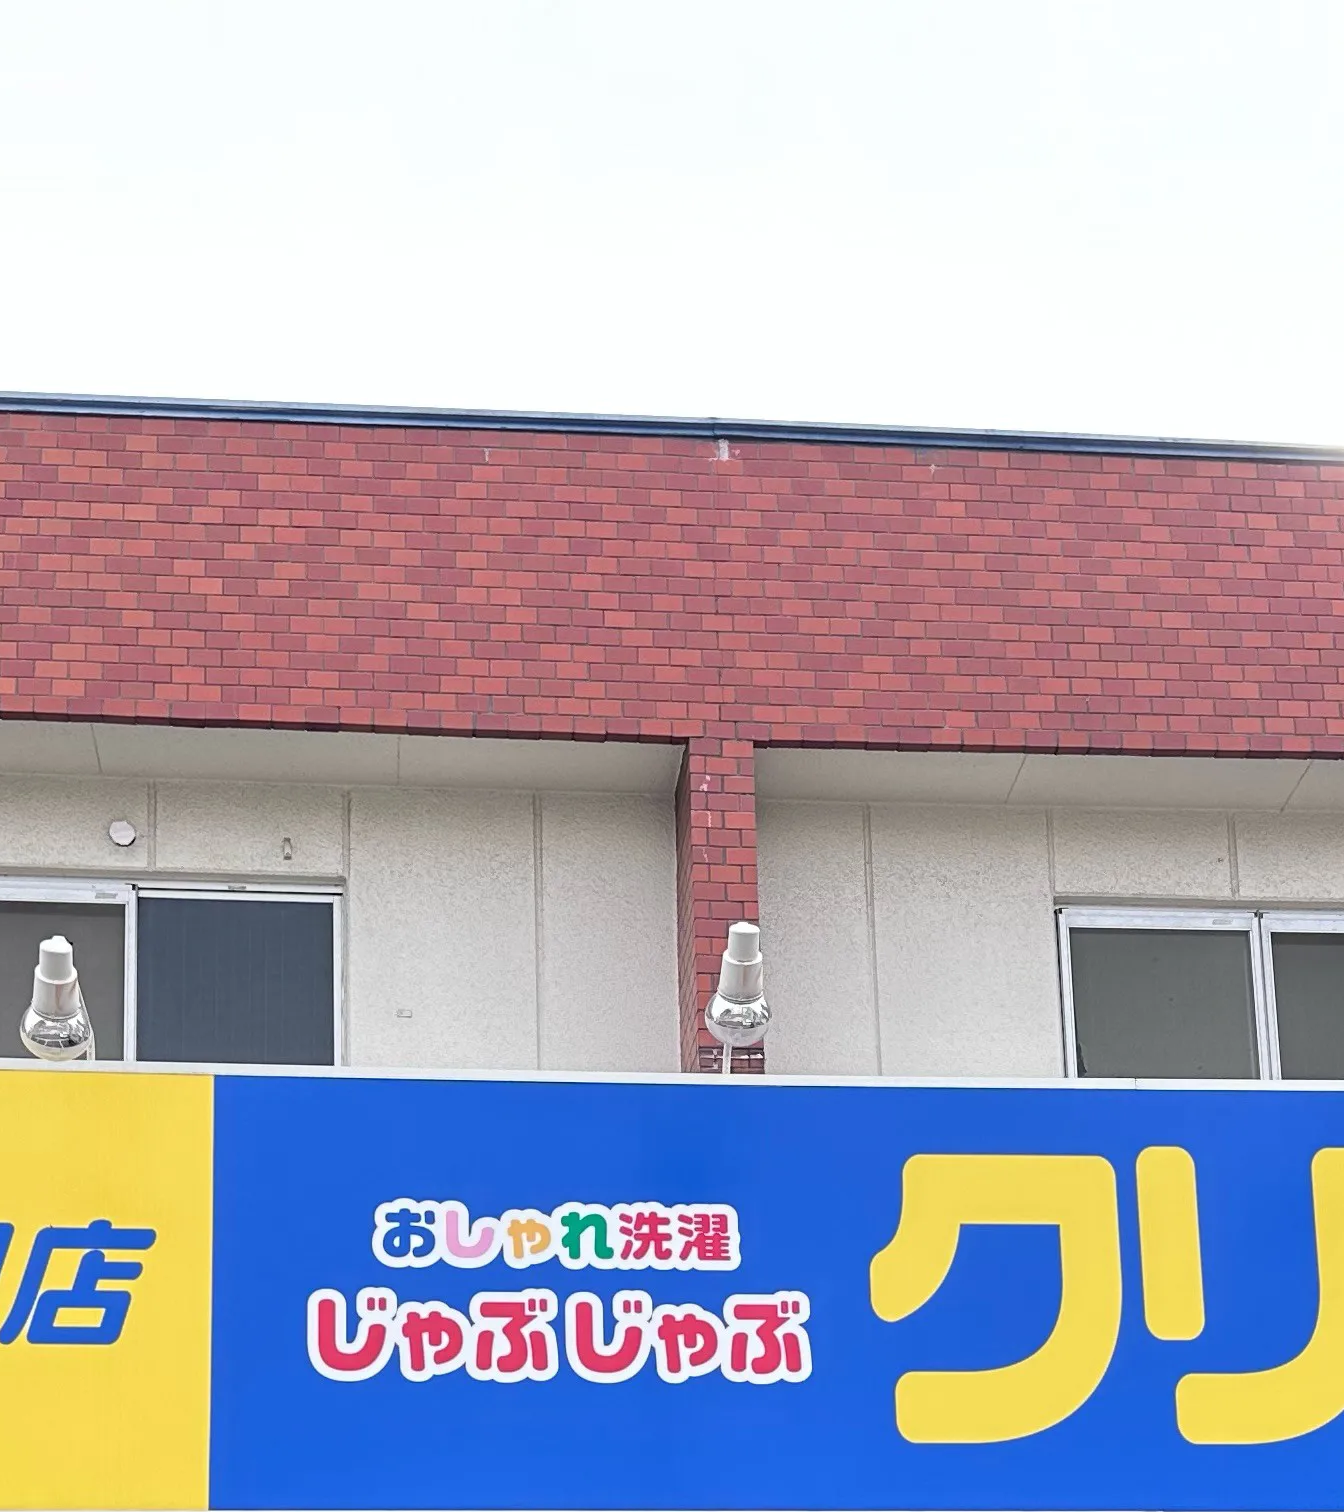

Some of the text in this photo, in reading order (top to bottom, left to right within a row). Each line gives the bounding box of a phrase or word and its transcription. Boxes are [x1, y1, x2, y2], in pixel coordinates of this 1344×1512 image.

[382, 1207, 731, 1262] おしゃれ洗濯
[316, 1298, 804, 1375] じゃぶじゃぶ
